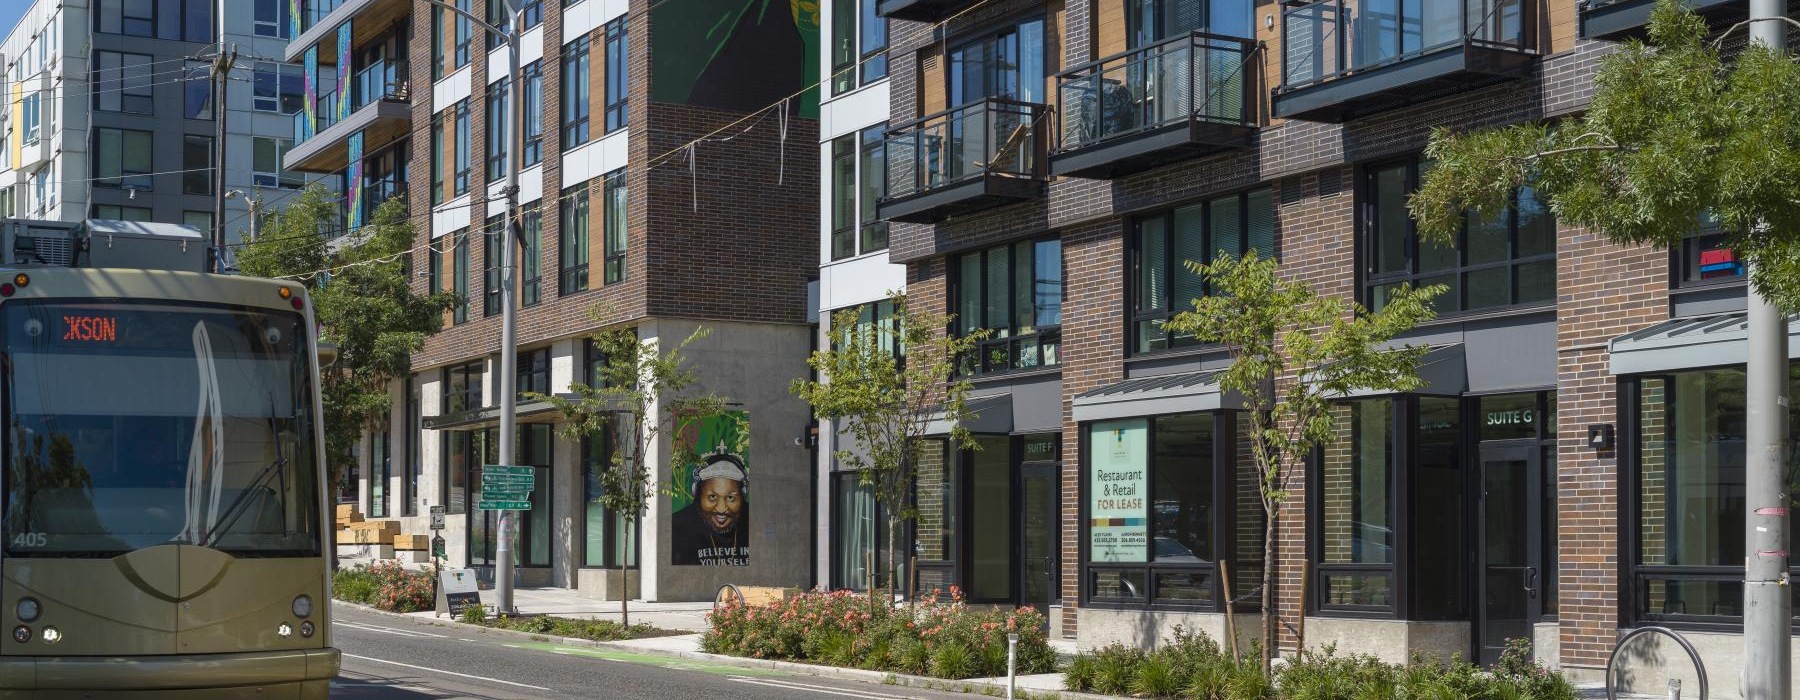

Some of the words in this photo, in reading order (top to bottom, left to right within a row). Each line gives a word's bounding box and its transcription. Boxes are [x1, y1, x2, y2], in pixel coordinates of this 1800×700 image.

[1488, 411, 1520, 425] SUITE
[1523, 410, 1532, 422] G
[1027, 443, 1047, 453] SUITE
[1048, 442, 1052, 451] F
[1097, 469, 1143, 481] Restaurant
[1104, 484, 1111, 497] &
[1113, 482, 1136, 496] Retail
[1097, 500, 1115, 510] FOR
[1117, 499, 1143, 509] LEASE
[14, 532, 48, 547] 405
[698, 547, 737, 558] BELIEVE
[740, 546, 750, 556] IN
